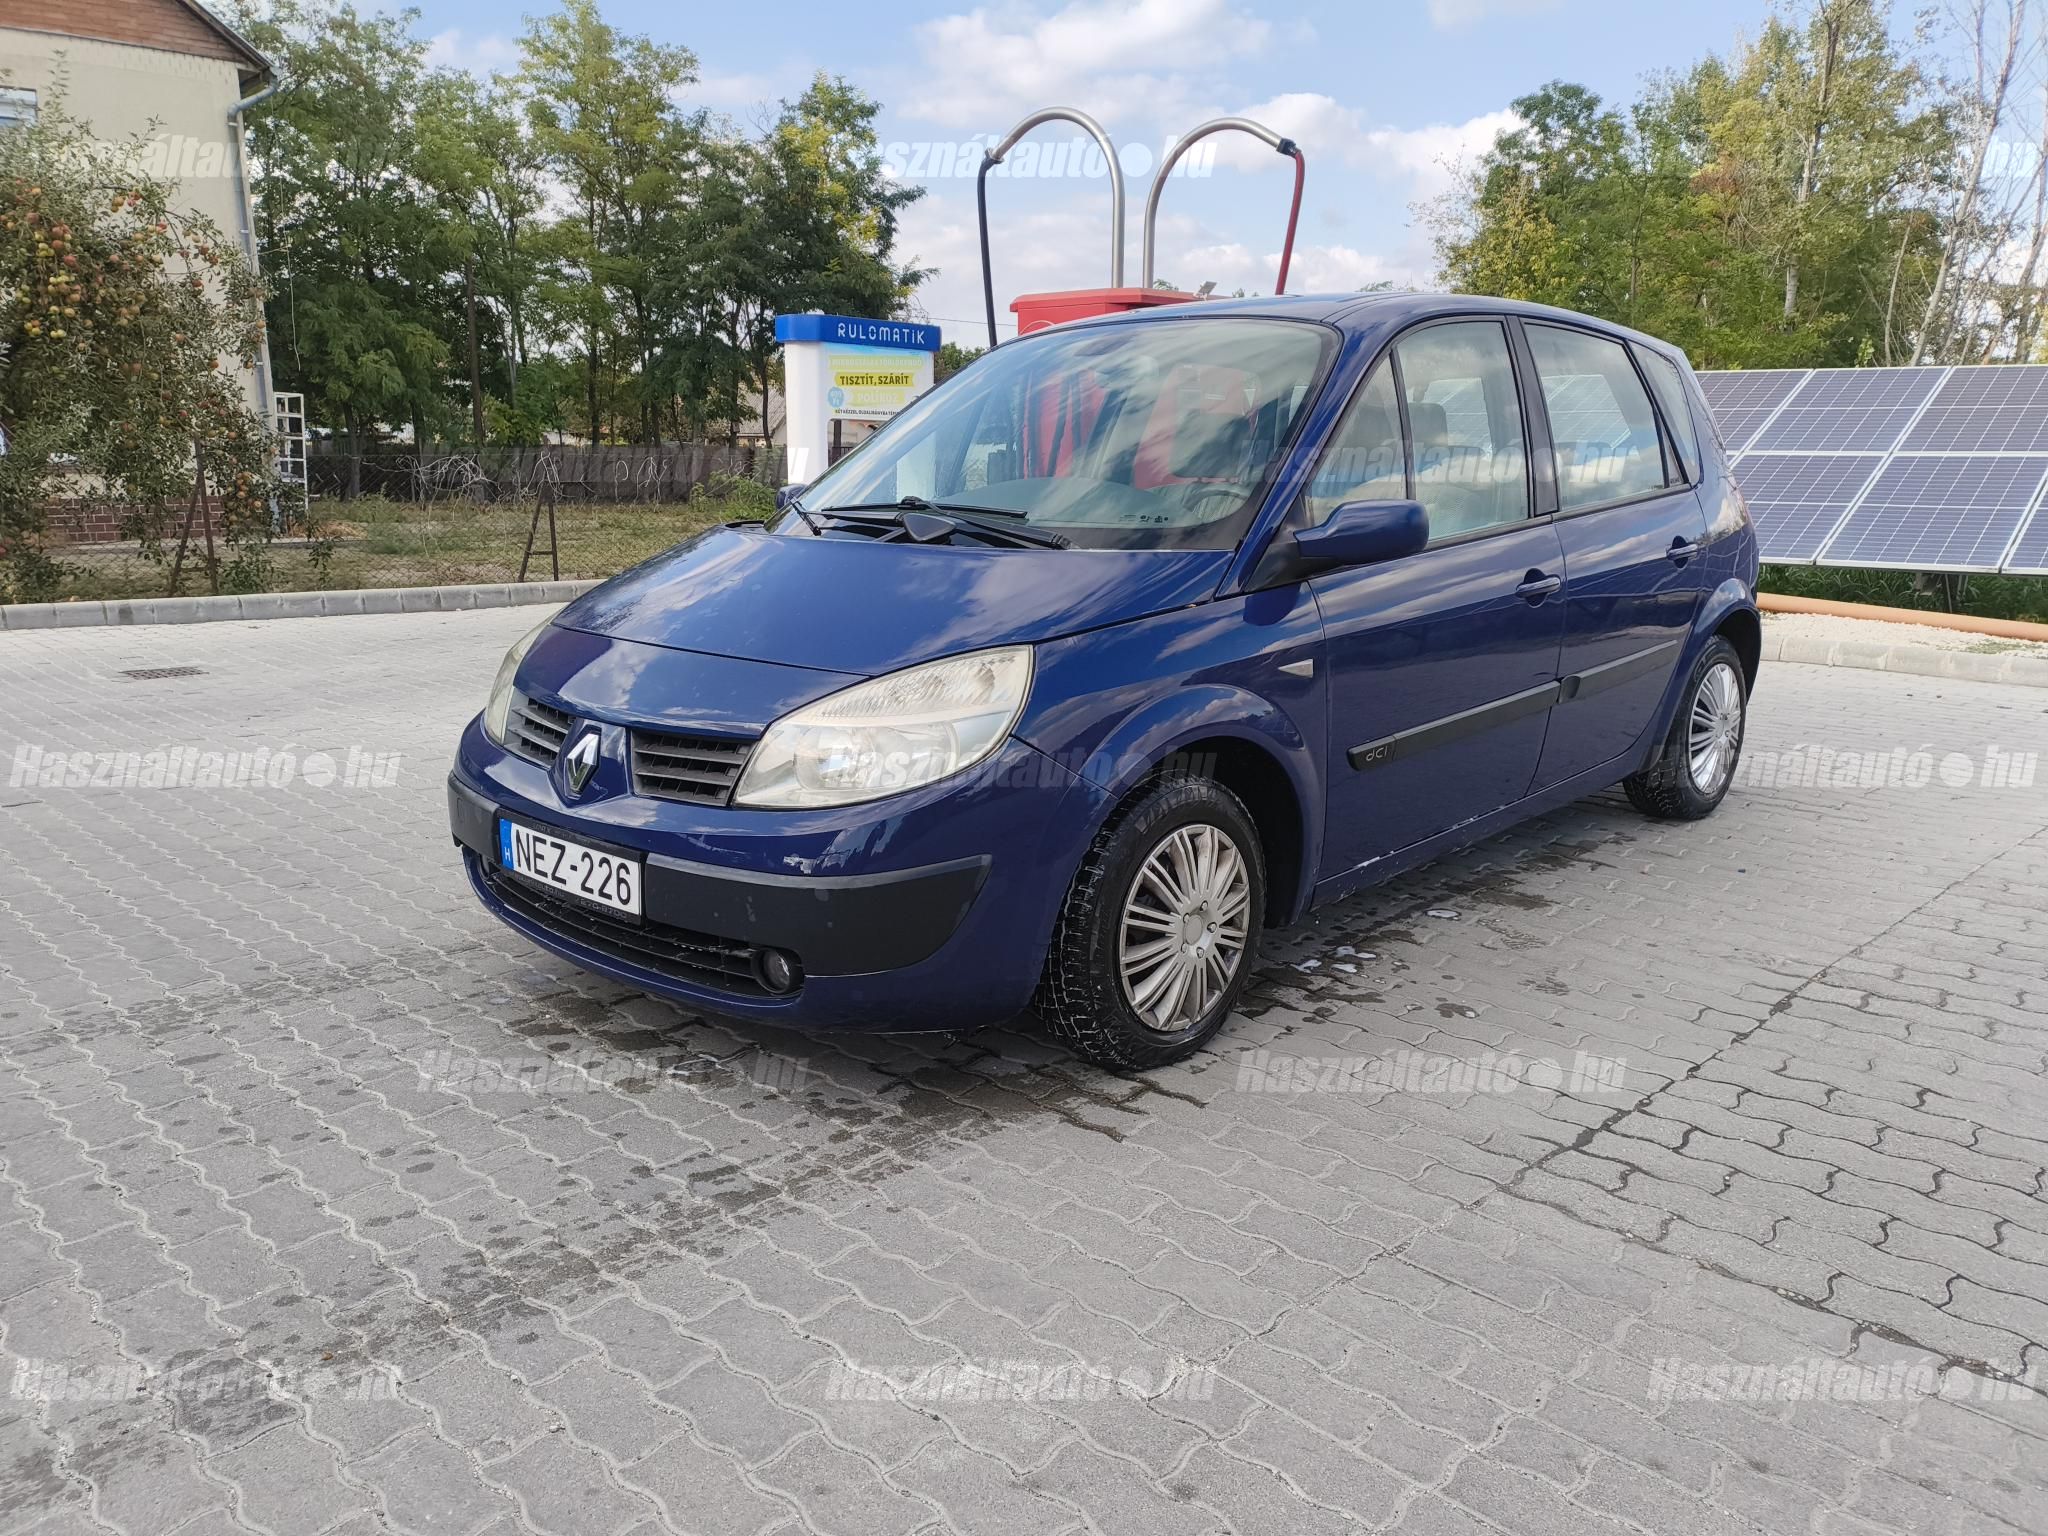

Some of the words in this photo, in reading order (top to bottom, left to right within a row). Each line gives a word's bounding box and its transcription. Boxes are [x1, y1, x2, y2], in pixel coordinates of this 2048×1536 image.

[837, 322, 925, 345] RULOMATIK
[840, 373, 877, 386] TISZTÍT,
[878, 372, 910, 385] SZÁRÍT
[504, 846, 511, 862] H
[515, 828, 632, 906] NEZ-226
